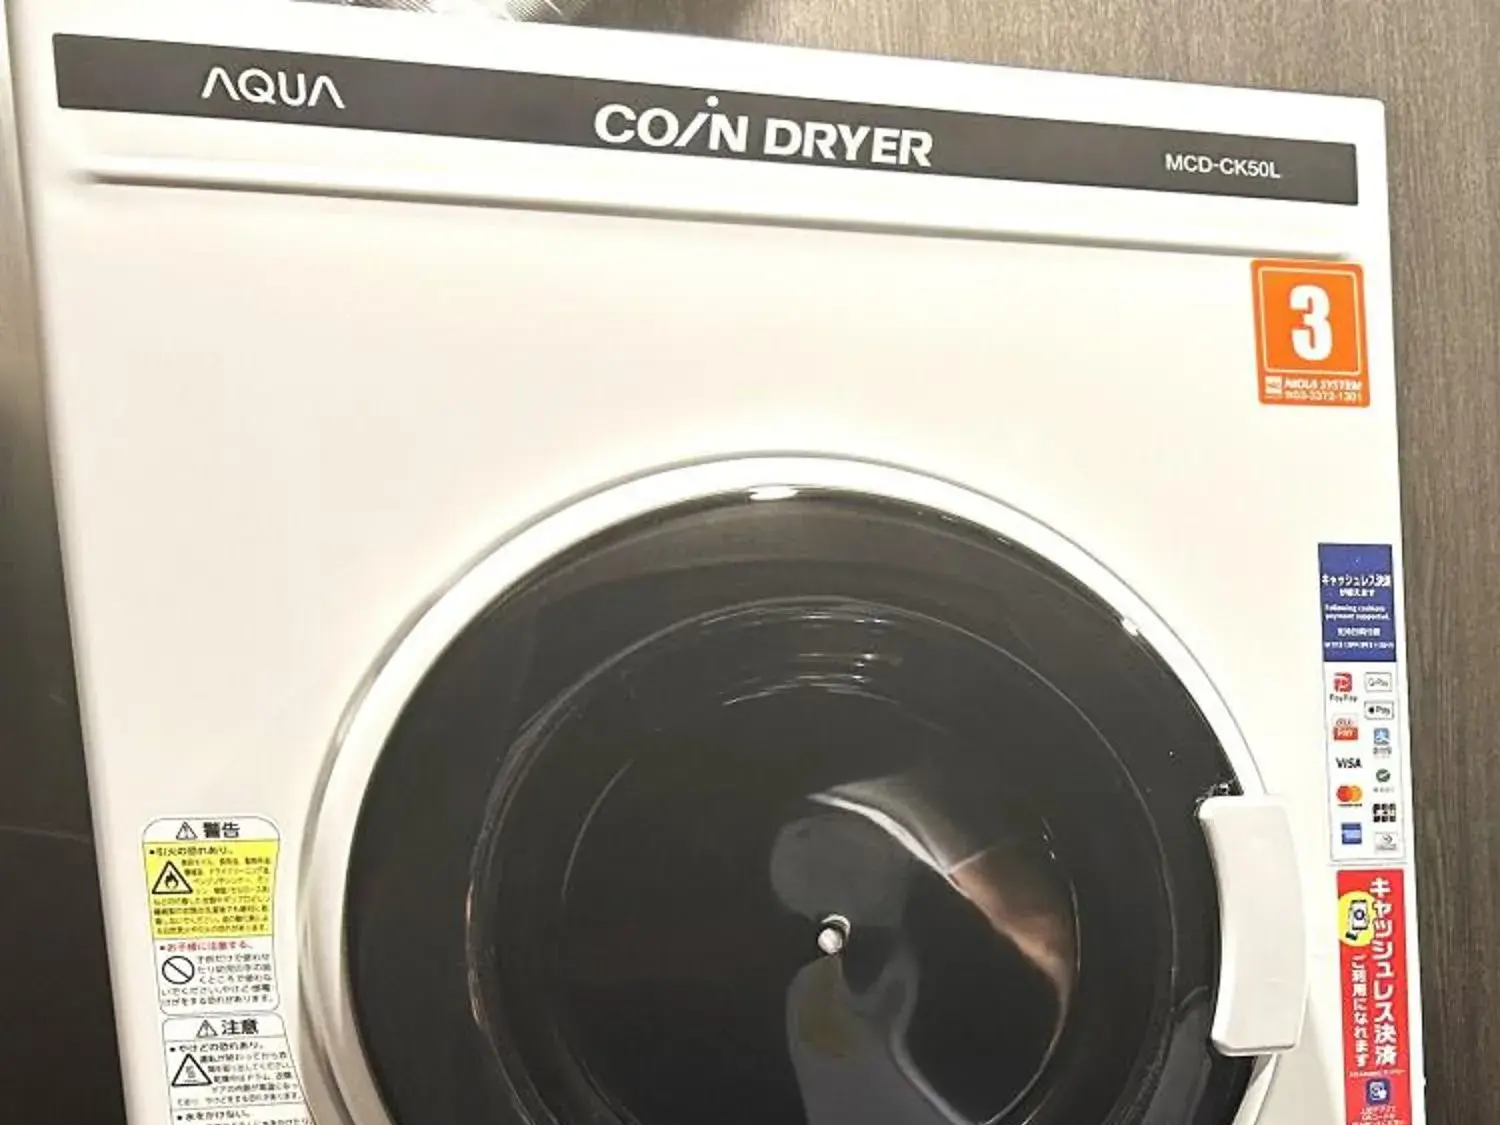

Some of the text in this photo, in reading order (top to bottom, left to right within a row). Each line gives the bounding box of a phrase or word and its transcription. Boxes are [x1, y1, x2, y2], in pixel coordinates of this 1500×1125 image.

[202, 66, 345, 110] AQUA
[594, 95, 933, 169] COIN DRYER
[1164, 153, 1281, 180] MCD-CK50L
[1289, 284, 1333, 362] 3
[1329, 693, 1358, 703] PayPay
[1375, 705, 1391, 716] Pay
[1336, 757, 1362, 769] VISA
[203, 821, 240, 839] 警告
[1369, 877, 1397, 1066] キャッシュレス決済
[221, 1019, 259, 1035] 注意
